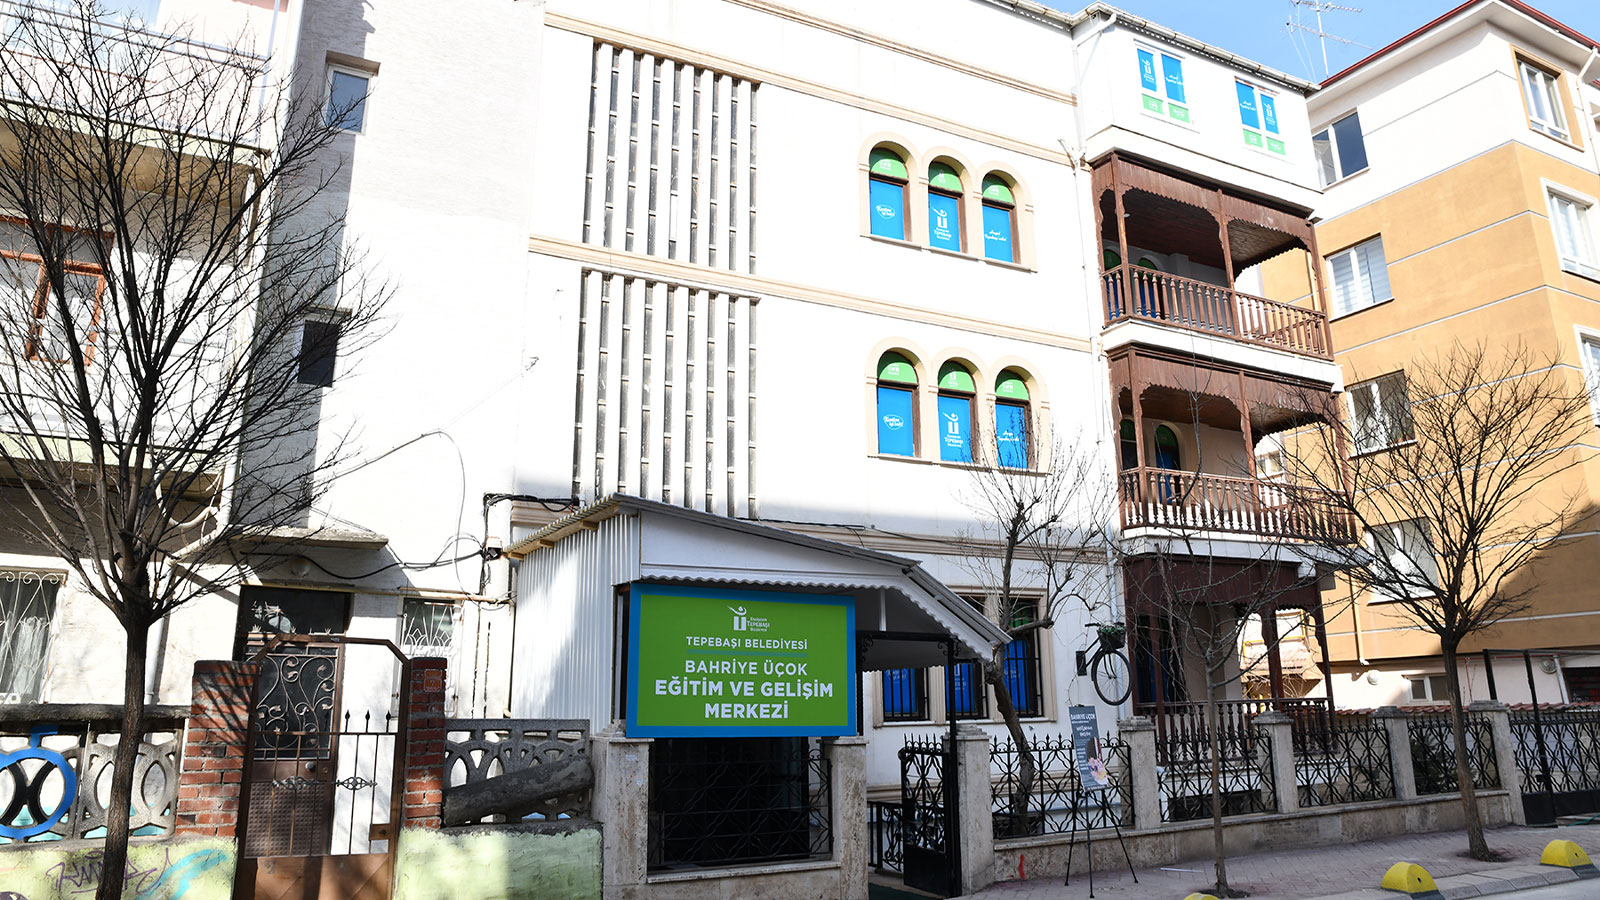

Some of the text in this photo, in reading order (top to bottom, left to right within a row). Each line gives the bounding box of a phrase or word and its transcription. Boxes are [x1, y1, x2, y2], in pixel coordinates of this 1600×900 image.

[686, 636, 808, 650] TEPEBAŞI BELEDİYESİ
[685, 658, 808, 678] BAHRİYE ÜÇOK
[655, 676, 833, 700] EĞİTİM VE GELİŞİM
[705, 700, 789, 719] MERKEZİ
